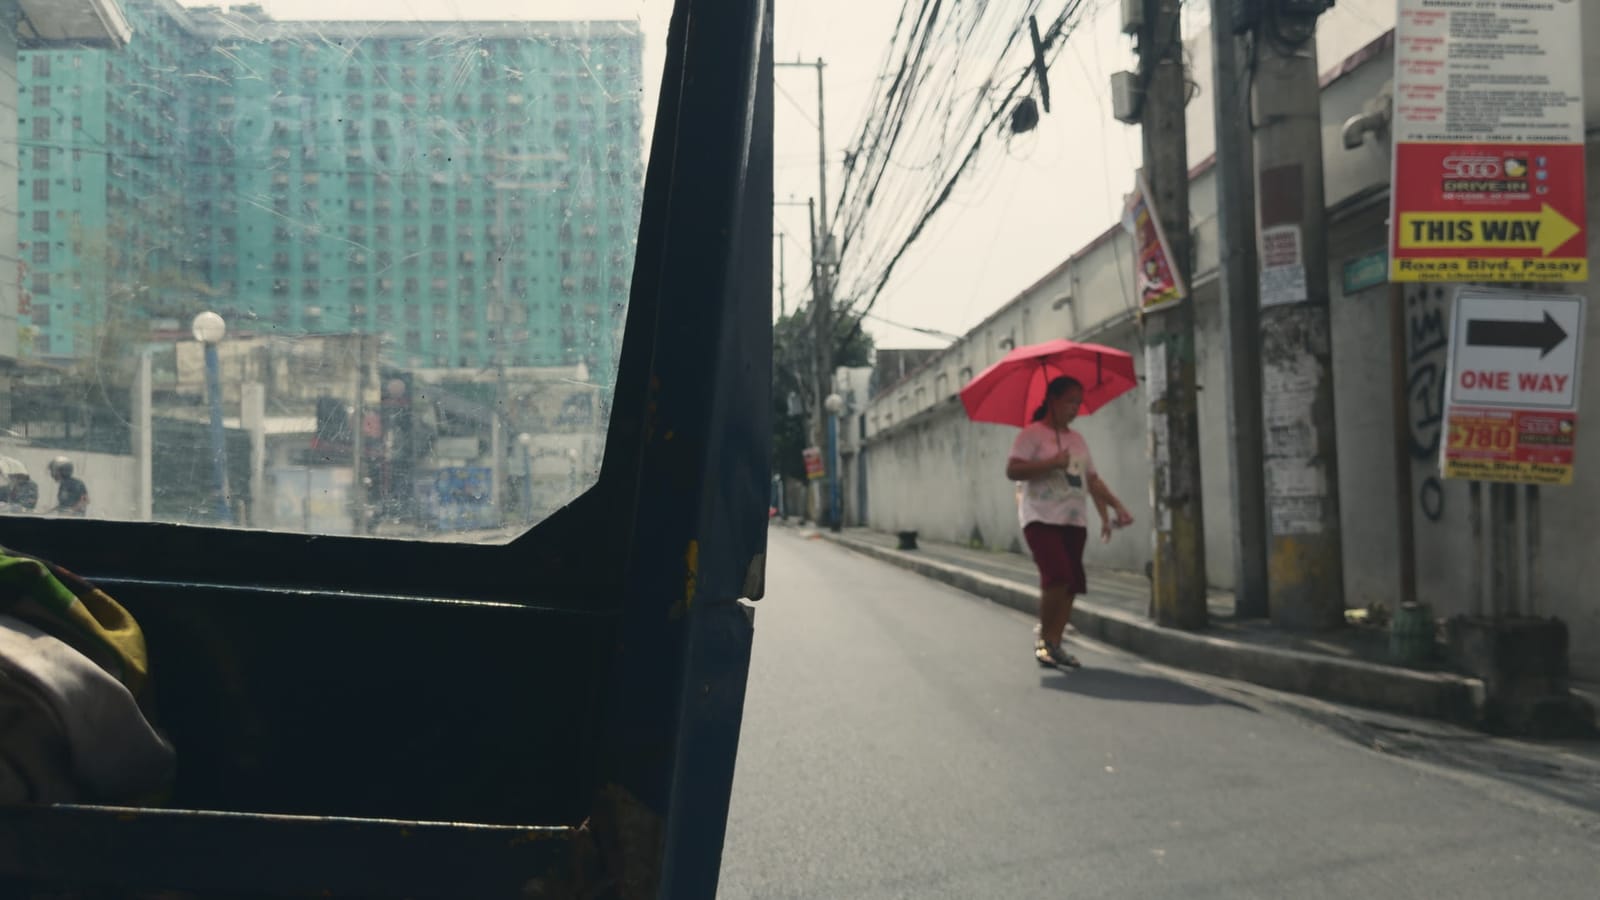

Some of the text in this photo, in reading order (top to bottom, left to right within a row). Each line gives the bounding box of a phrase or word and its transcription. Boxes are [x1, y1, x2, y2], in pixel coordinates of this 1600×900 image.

[1444, 181, 1528, 192] DRIVE-IN
[1411, 220, 1541, 242] THIS WAY
[1400, 259, 1460, 271] Roxas
[1523, 260, 1582, 273] Pasay
[1460, 370, 1569, 393] ONE WAY
